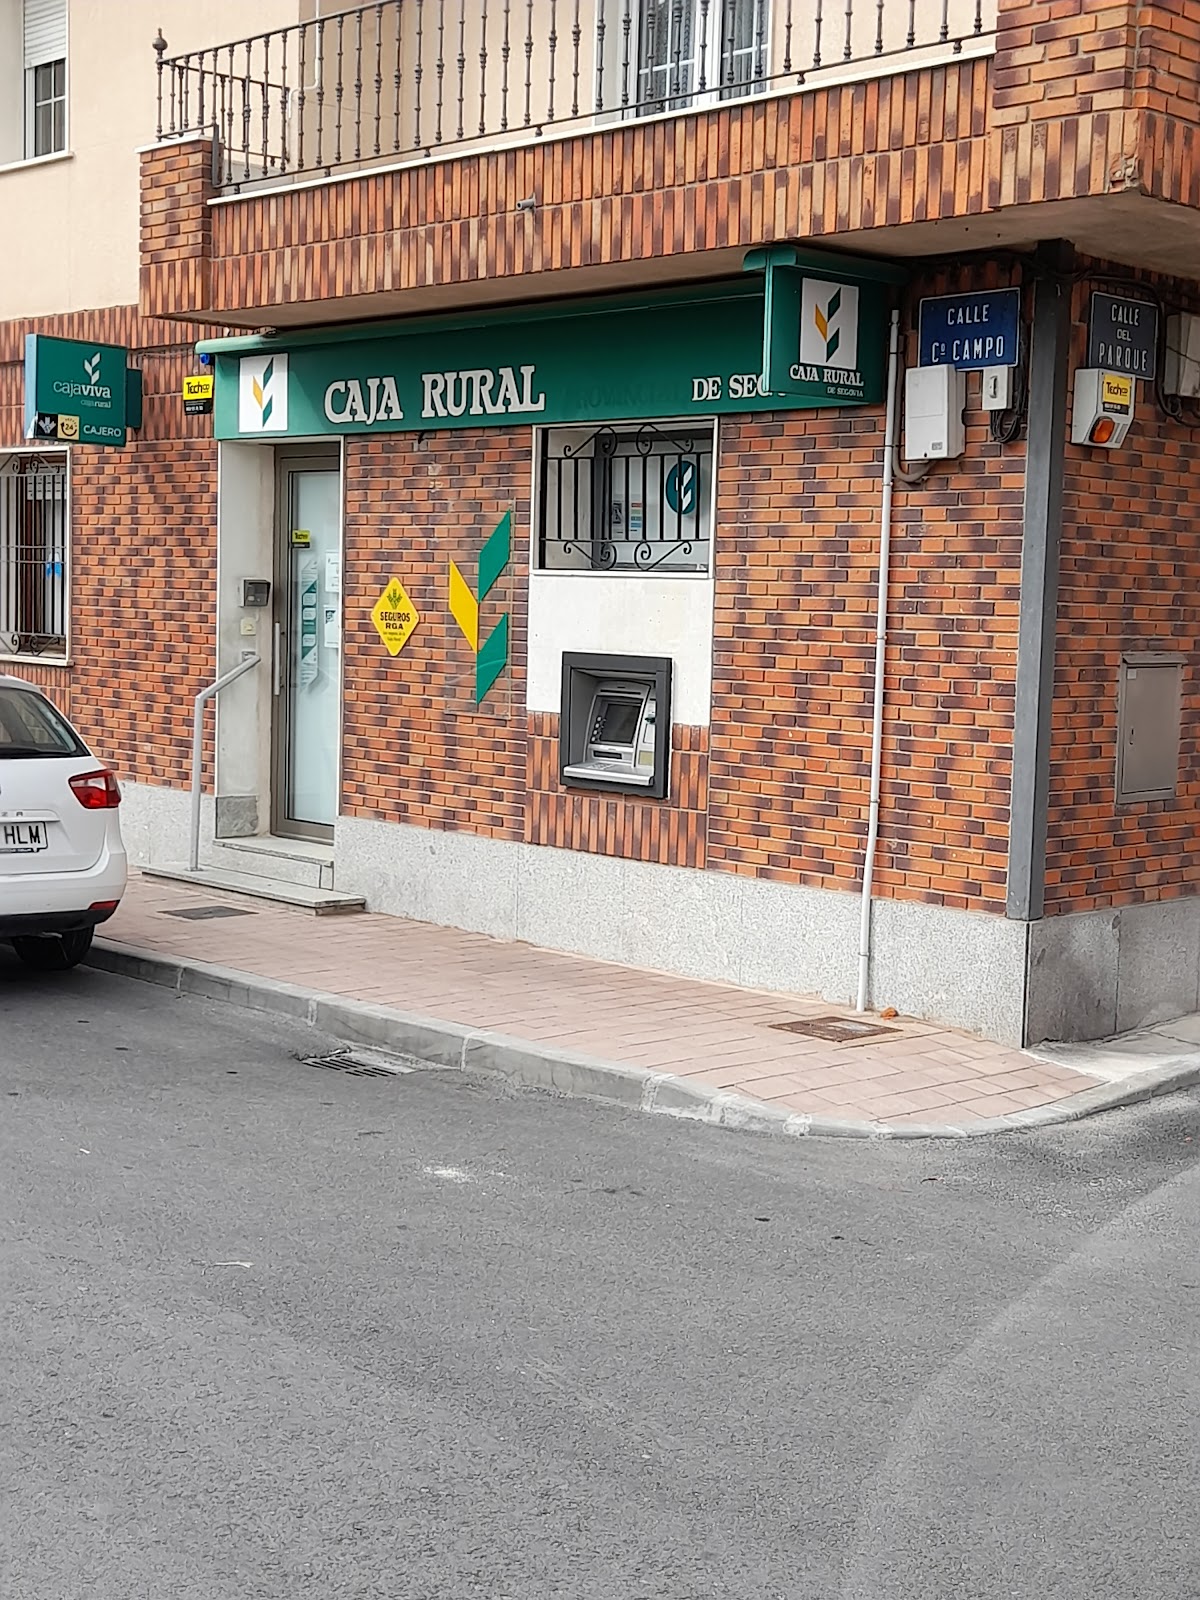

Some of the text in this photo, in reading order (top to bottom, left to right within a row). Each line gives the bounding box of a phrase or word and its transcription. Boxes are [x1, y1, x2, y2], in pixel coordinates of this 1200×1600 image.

[947, 304, 990, 326] CALLE
[1111, 304, 1139, 326] CALLE
[1116, 328, 1132, 342] DEL
[952, 335, 1004, 361] CAMPO
[1098, 342, 1148, 372] PARQUE
[789, 364, 864, 387] CAJA RURAL
[53, 380, 112, 399] cajaviva
[324, 376, 403, 425] CAJA
[421, 365, 545, 418] RURAL
[692, 376, 722, 402] DE
[827, 386, 864, 398] DE SEGOVIA
[65, 423, 74, 431] 24
[83, 424, 122, 438] CAJERO
[380, 611, 411, 623] SEGUROS
[385, 622, 404, 630] RGA
[3, 825, 41, 845] HLM
